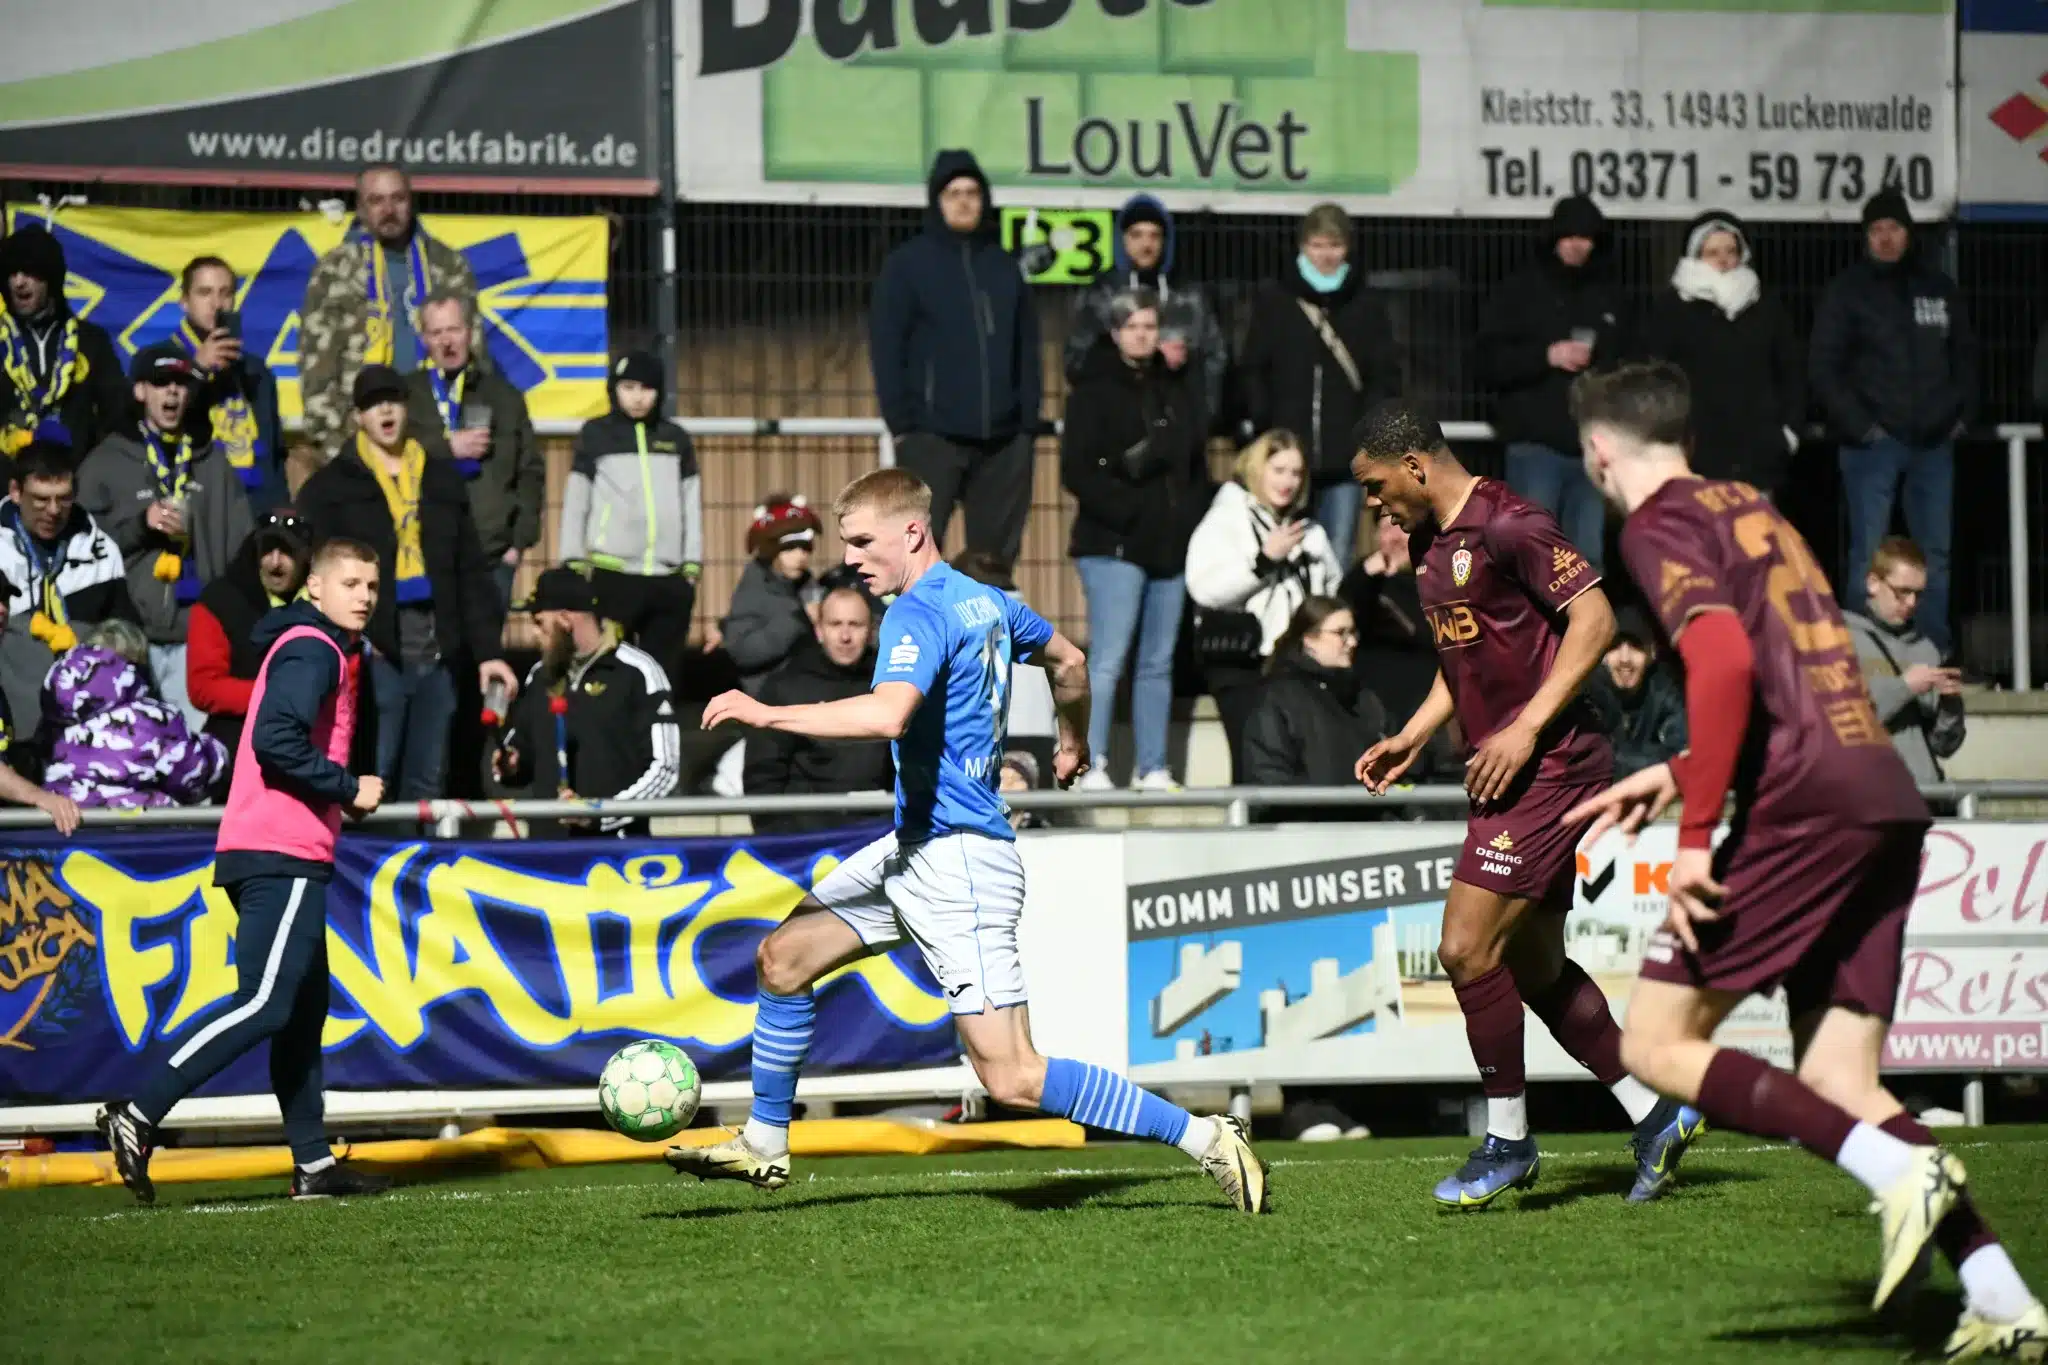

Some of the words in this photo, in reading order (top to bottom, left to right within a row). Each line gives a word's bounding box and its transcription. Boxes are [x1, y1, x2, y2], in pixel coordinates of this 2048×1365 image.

[1481, 86, 1603, 126] Kleiststr.
[1611, 89, 1655, 132] 33,
[1664, 90, 1747, 129] 14943
[1757, 91, 1932, 132] Luckenwalde
[187, 126, 638, 167] www.diedruckfabrik.de
[1025, 97, 1310, 181] LouVet
[1480, 146, 1554, 197] Tel.
[1570, 149, 1698, 200] 03371
[1749, 151, 1799, 201] 59
[1814, 152, 1865, 201] 73
[1548, 560, 1591, 594] DEBA
[1475, 846, 1524, 865] DEBAG
[1480, 860, 1512, 876] JAKO
[1130, 886, 1234, 931] KOMM
[1245, 880, 1281, 915] IN
[1291, 863, 1407, 910] UNSER
